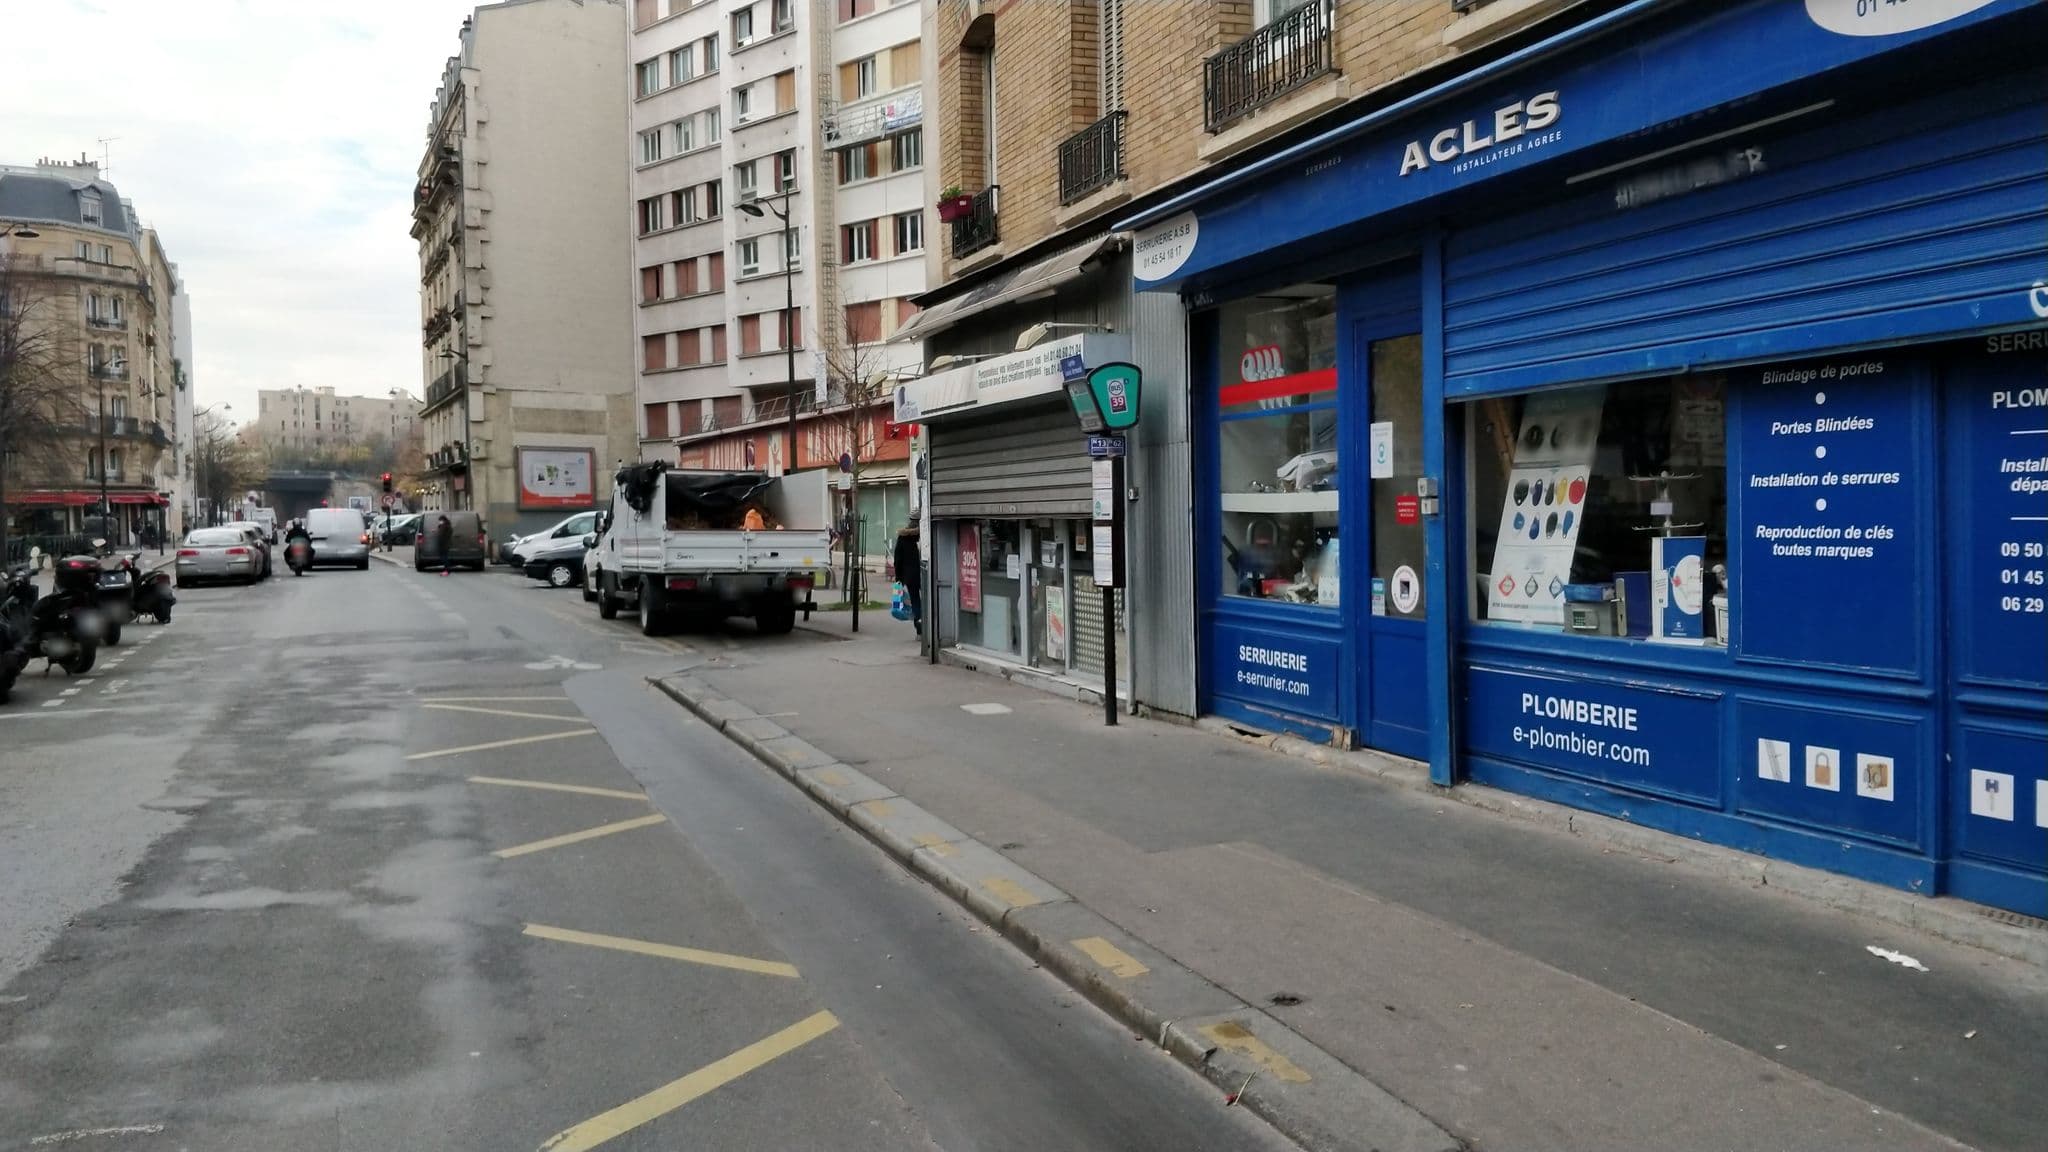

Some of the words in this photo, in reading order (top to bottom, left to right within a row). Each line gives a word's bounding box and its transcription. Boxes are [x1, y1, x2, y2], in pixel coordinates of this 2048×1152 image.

[1398, 90, 1562, 177] ACLES
[1452, 143, 1524, 175] INSTALLATEUR
[1527, 130, 1563, 150] AGREE
[1136, 230, 1173, 254] SERRURERIE
[1986, 331, 2048, 353] SERR
[1762, 369, 1817, 385] Blindage
[1820, 365, 1837, 379] de
[1839, 361, 1884, 380] portes
[1110, 384, 1121, 392] BUS
[1112, 397, 1124, 407] 39
[1771, 421, 1812, 436] Portes
[1815, 415, 1874, 433] Blindées
[807, 416, 876, 464] NATURAIA
[1750, 473, 1819, 487] Installation
[1821, 471, 1839, 486] de
[1841, 472, 1900, 486] serrures
[1755, 524, 1841, 542] Reproduction
[1844, 525, 1862, 539] de
[1864, 524, 1894, 540] clés
[962, 551, 977, 567] 30%
[1772, 543, 1812, 556] toutes
[1815, 545, 1874, 560] marques
[2001, 542, 2020, 558] 09
[2024, 542, 2044, 558] 50
[2001, 569, 2019, 584] 01
[2024, 570, 2044, 585] 45
[2002, 596, 2021, 611] 06
[2025, 597, 2044, 613] 29
[1239, 644, 1308, 673] SERRURERIE
[1237, 670, 1310, 697] e-serrurier.com
[1522, 692, 1638, 731] PLOMBERIE
[1513, 725, 1650, 766] e-plombier.com
